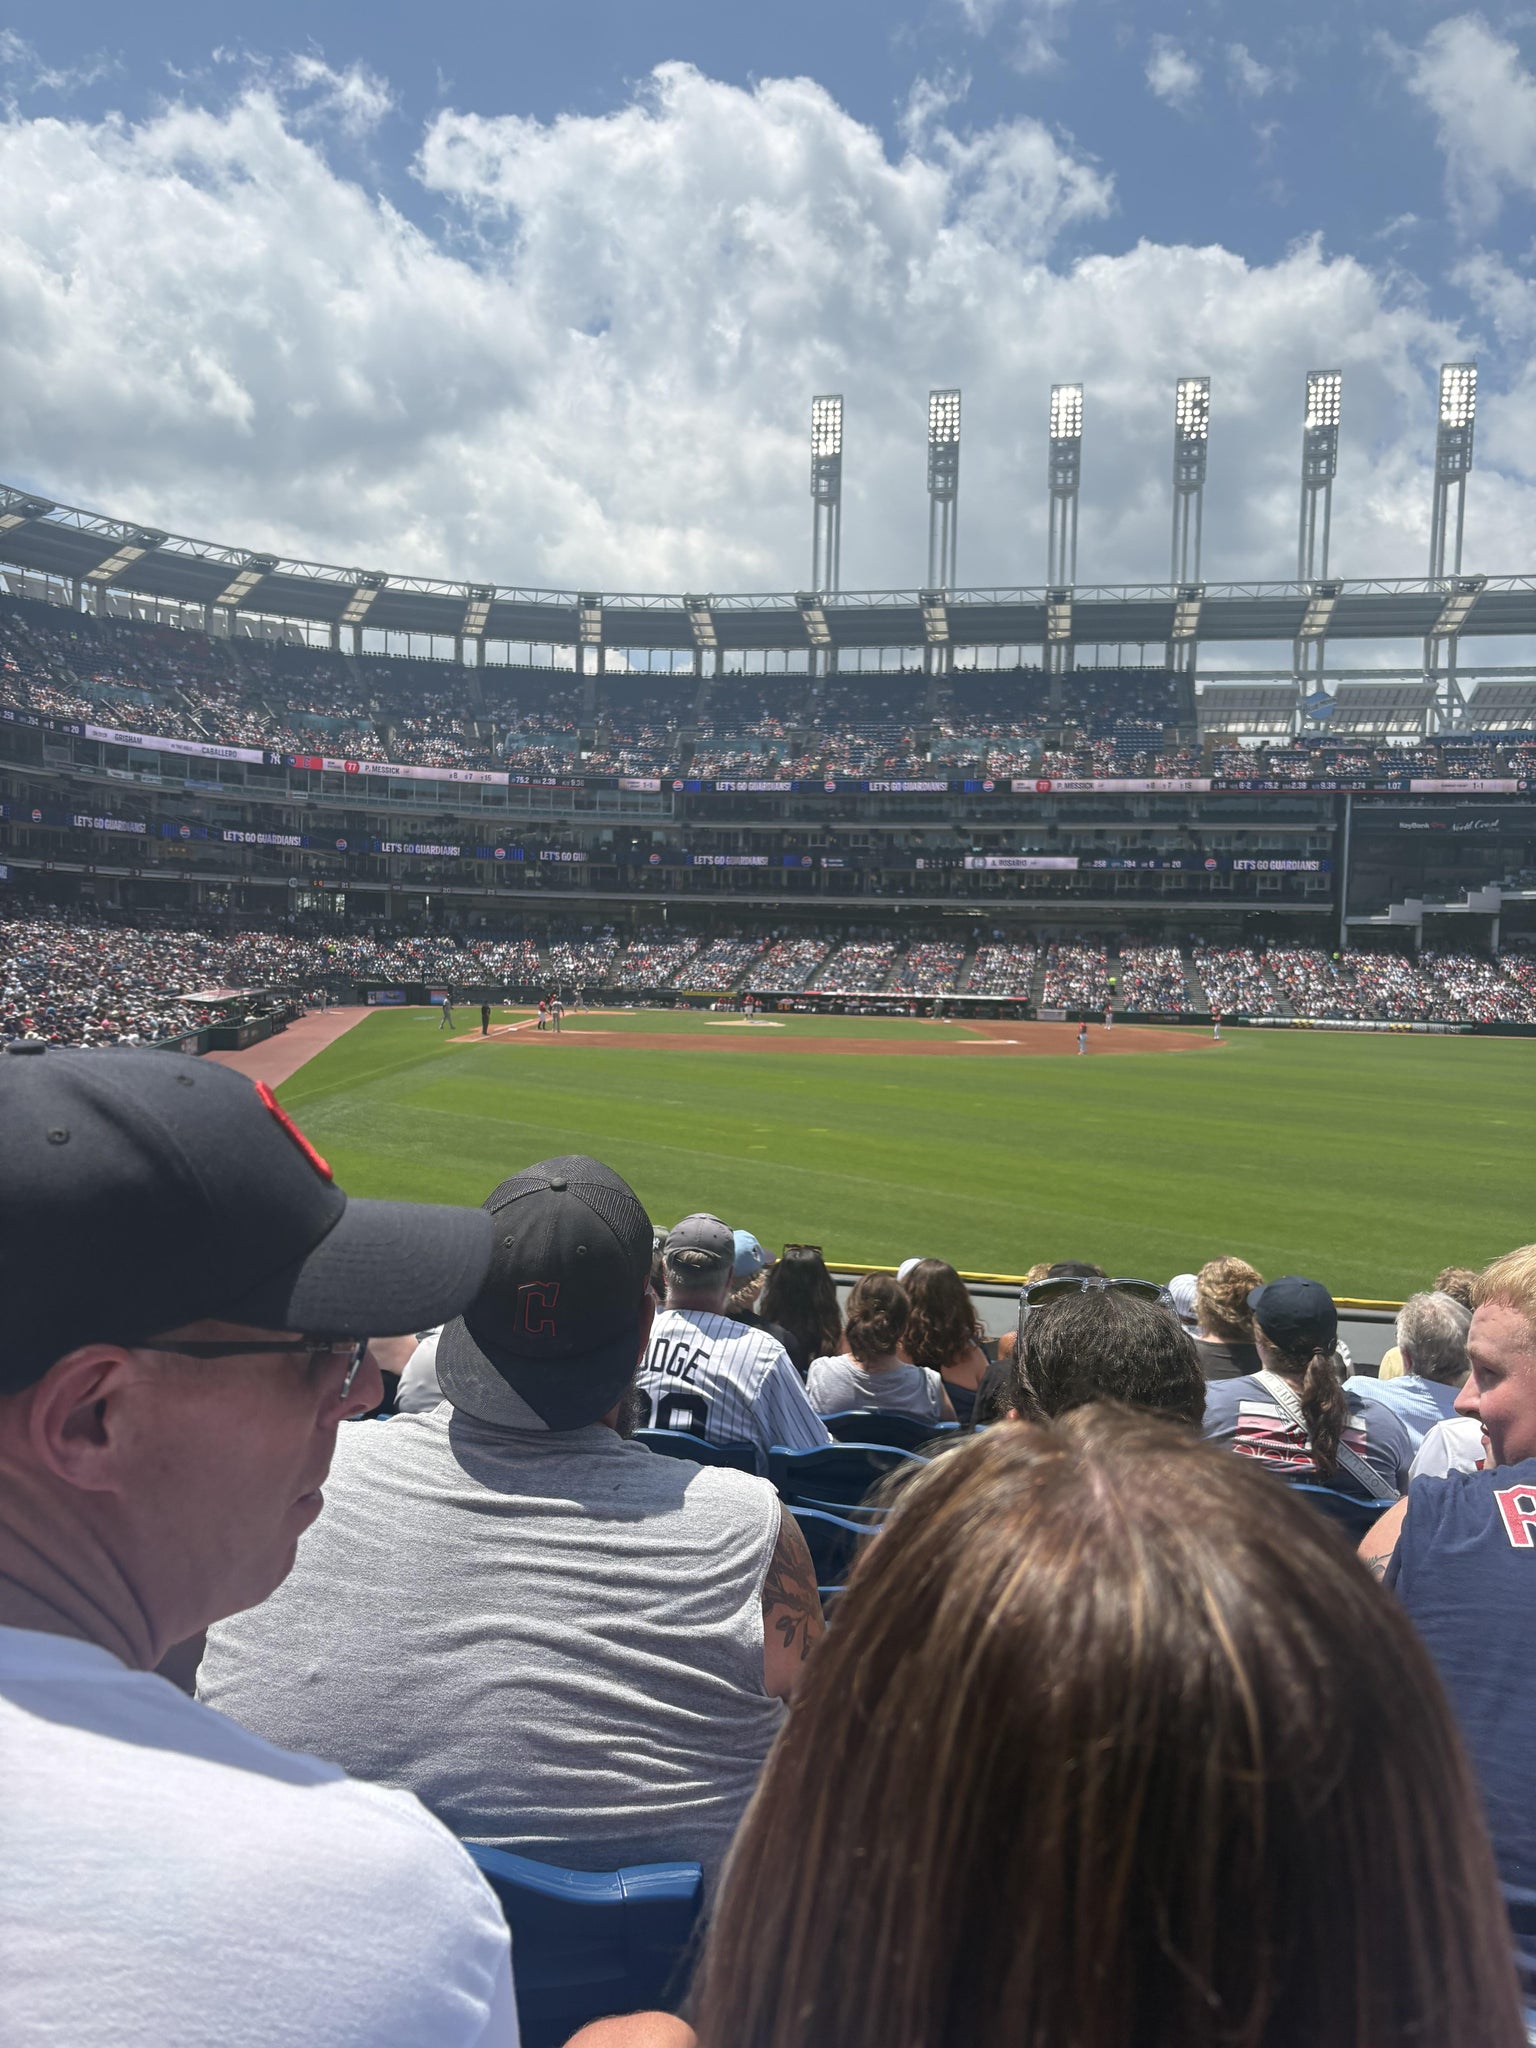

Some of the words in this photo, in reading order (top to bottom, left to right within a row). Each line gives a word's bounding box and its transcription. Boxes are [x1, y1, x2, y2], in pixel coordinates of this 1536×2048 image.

[114, 733, 143, 745] GRISHAM
[201, 746, 238, 758] CABALLERO
[346, 762, 358, 771] 77
[371, 765, 401, 775] MESSICK
[715, 782, 736, 791] LET'S
[737, 782, 748, 791] GO
[869, 782, 890, 792] LET'S
[891, 782, 902, 792] GO
[73, 814, 93, 828] LET'S
[94, 816, 104, 830] GO
[104, 818, 147, 834] GUARDIANS!
[223, 830, 245, 842] LET'S
[245, 832, 256, 843] GO
[257, 832, 302, 847] GUARDIANS!
[381, 842, 403, 854] LET'S
[403, 843, 415, 854] GO
[415, 843, 461, 857] GUARDIANS!
[540, 851, 561, 861] LET'S
[561, 852, 572, 861] GO
[693, 855, 714, 865] LET'S
[714, 855, 725, 865] GO
[1233, 859, 1256, 870] LET'S
[1256, 859, 1269, 871] GO
[1269, 859, 1320, 871] GUARDIANS!
